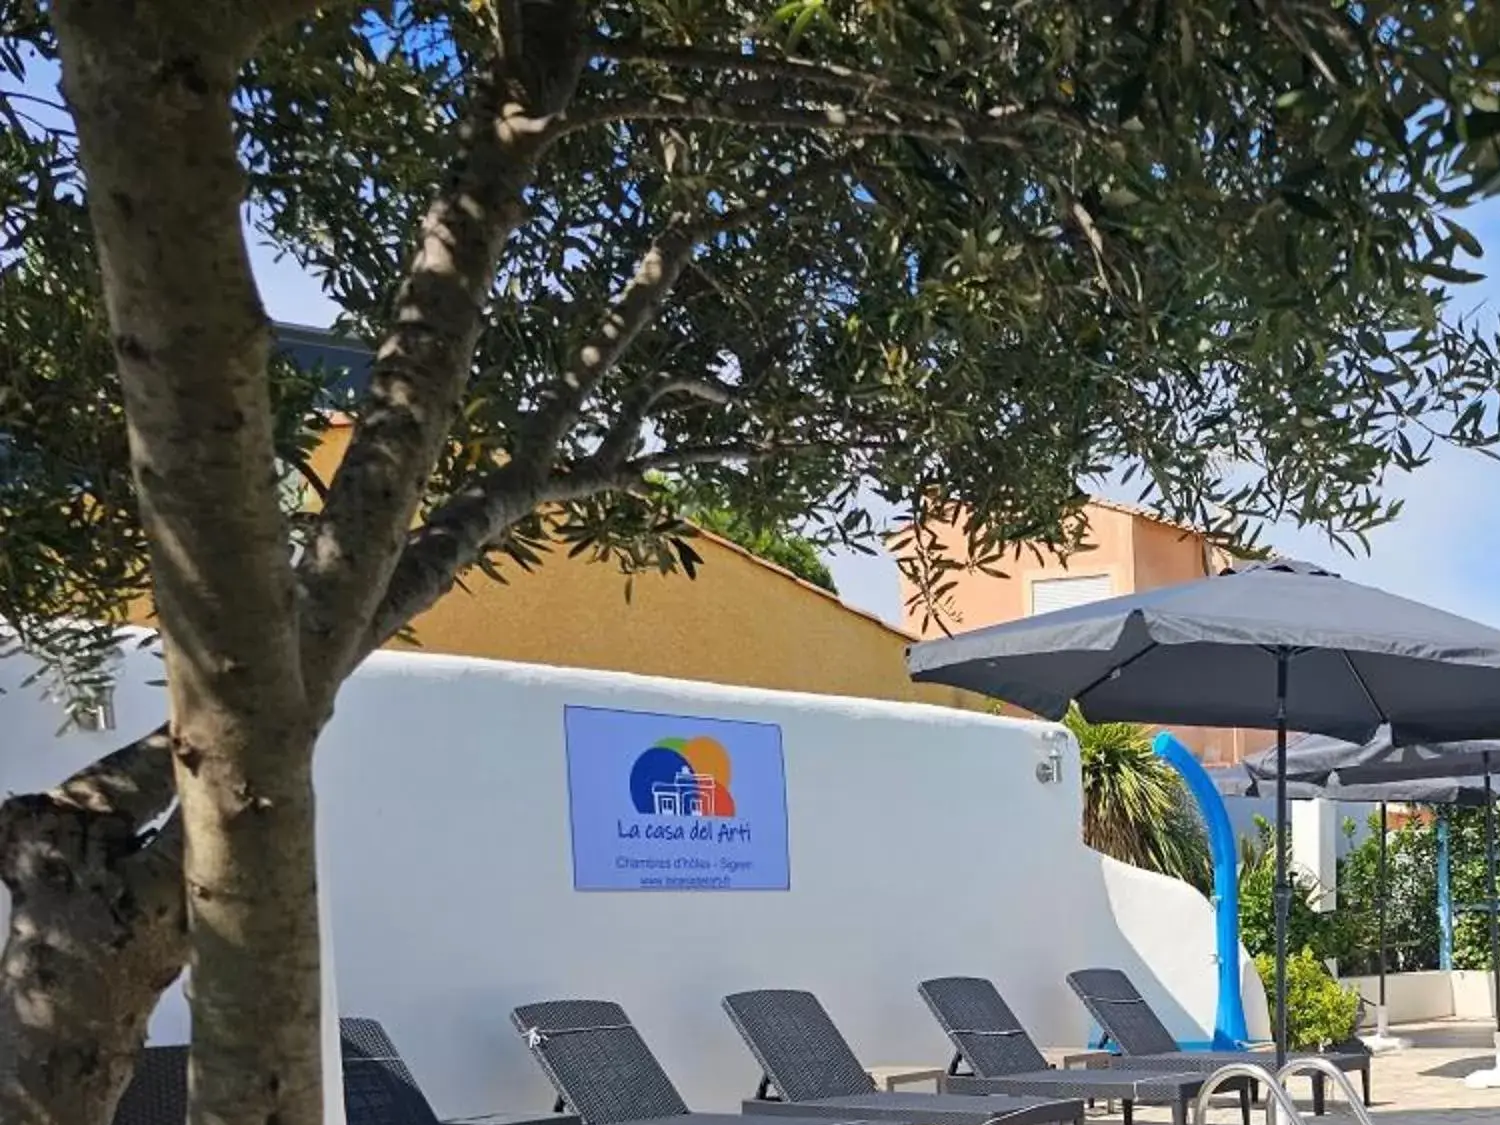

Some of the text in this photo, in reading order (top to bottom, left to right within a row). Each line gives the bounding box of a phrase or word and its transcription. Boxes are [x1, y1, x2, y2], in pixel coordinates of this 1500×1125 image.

[617, 819, 751, 843] La casa del Arti
